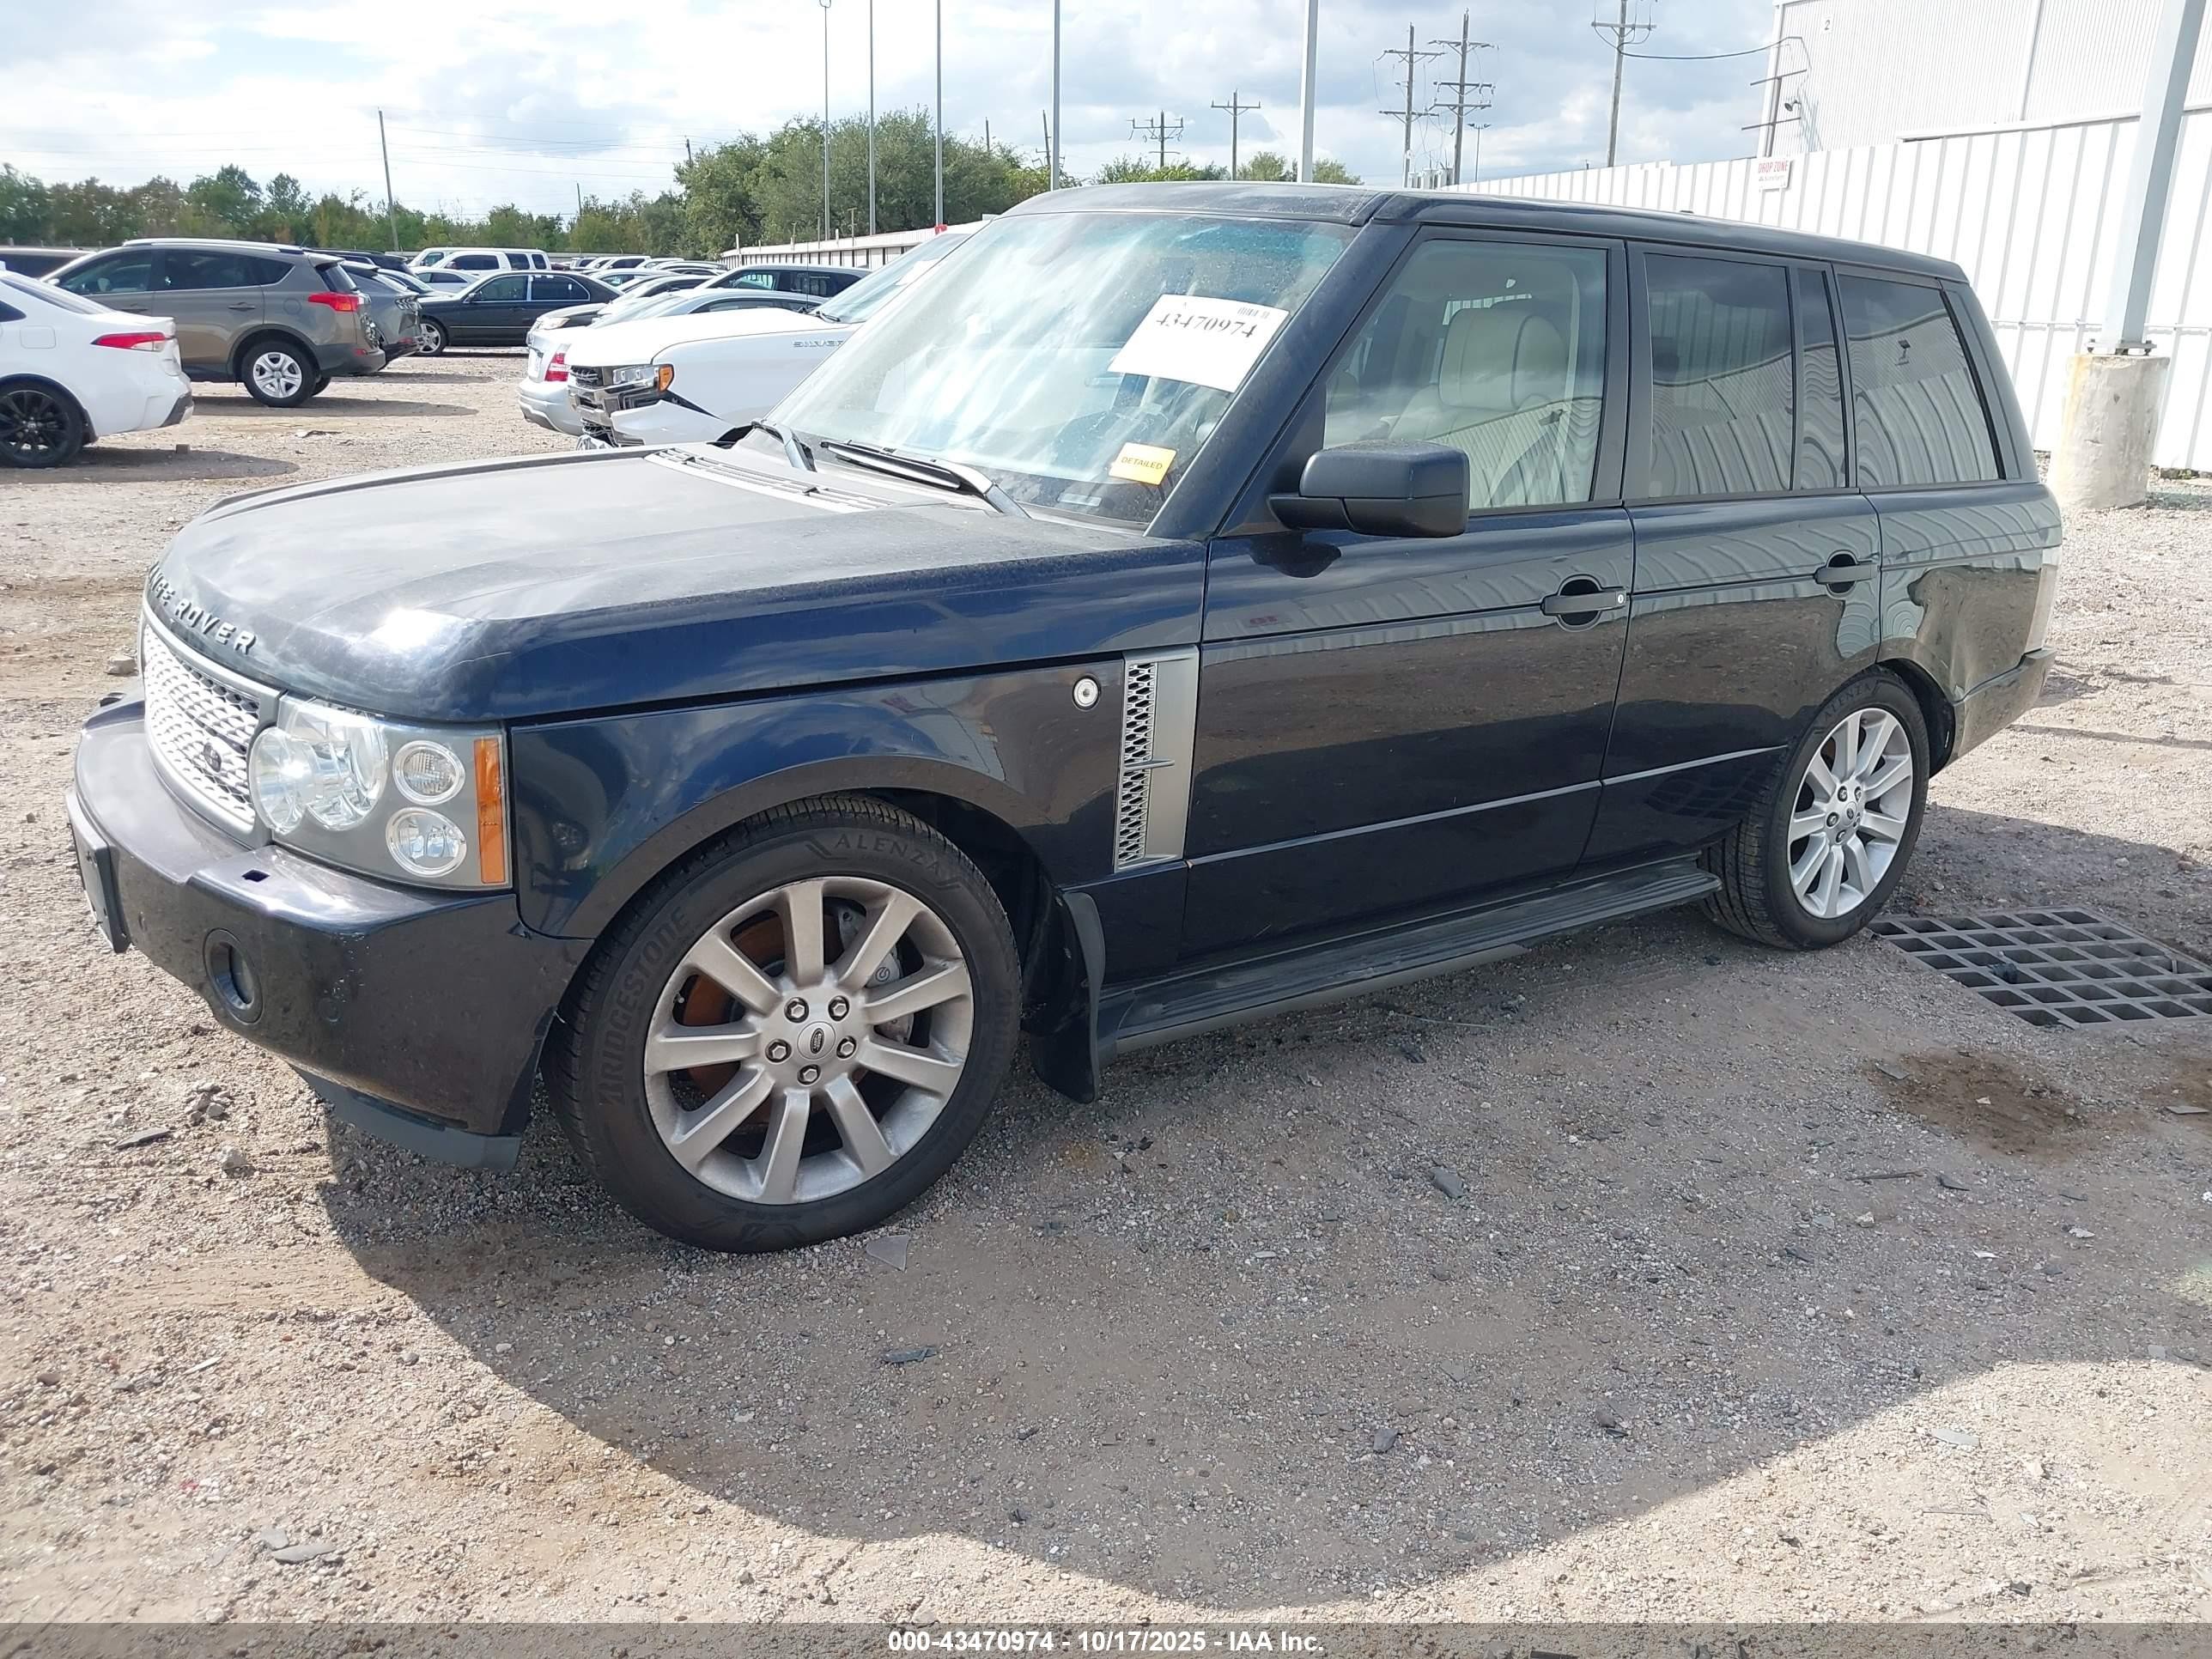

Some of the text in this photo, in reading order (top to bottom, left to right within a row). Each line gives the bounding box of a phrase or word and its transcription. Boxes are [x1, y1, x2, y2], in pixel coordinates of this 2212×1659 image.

[1758, 160, 1789, 173] DROP ZONE
[1156, 313, 1259, 338] 43470974
[1121, 456, 1164, 470] DETAILED
[174, 599, 257, 655] ROVER
[834, 833, 944, 877] ALENZA
[599, 906, 688, 1106] BRIDGESTONE
